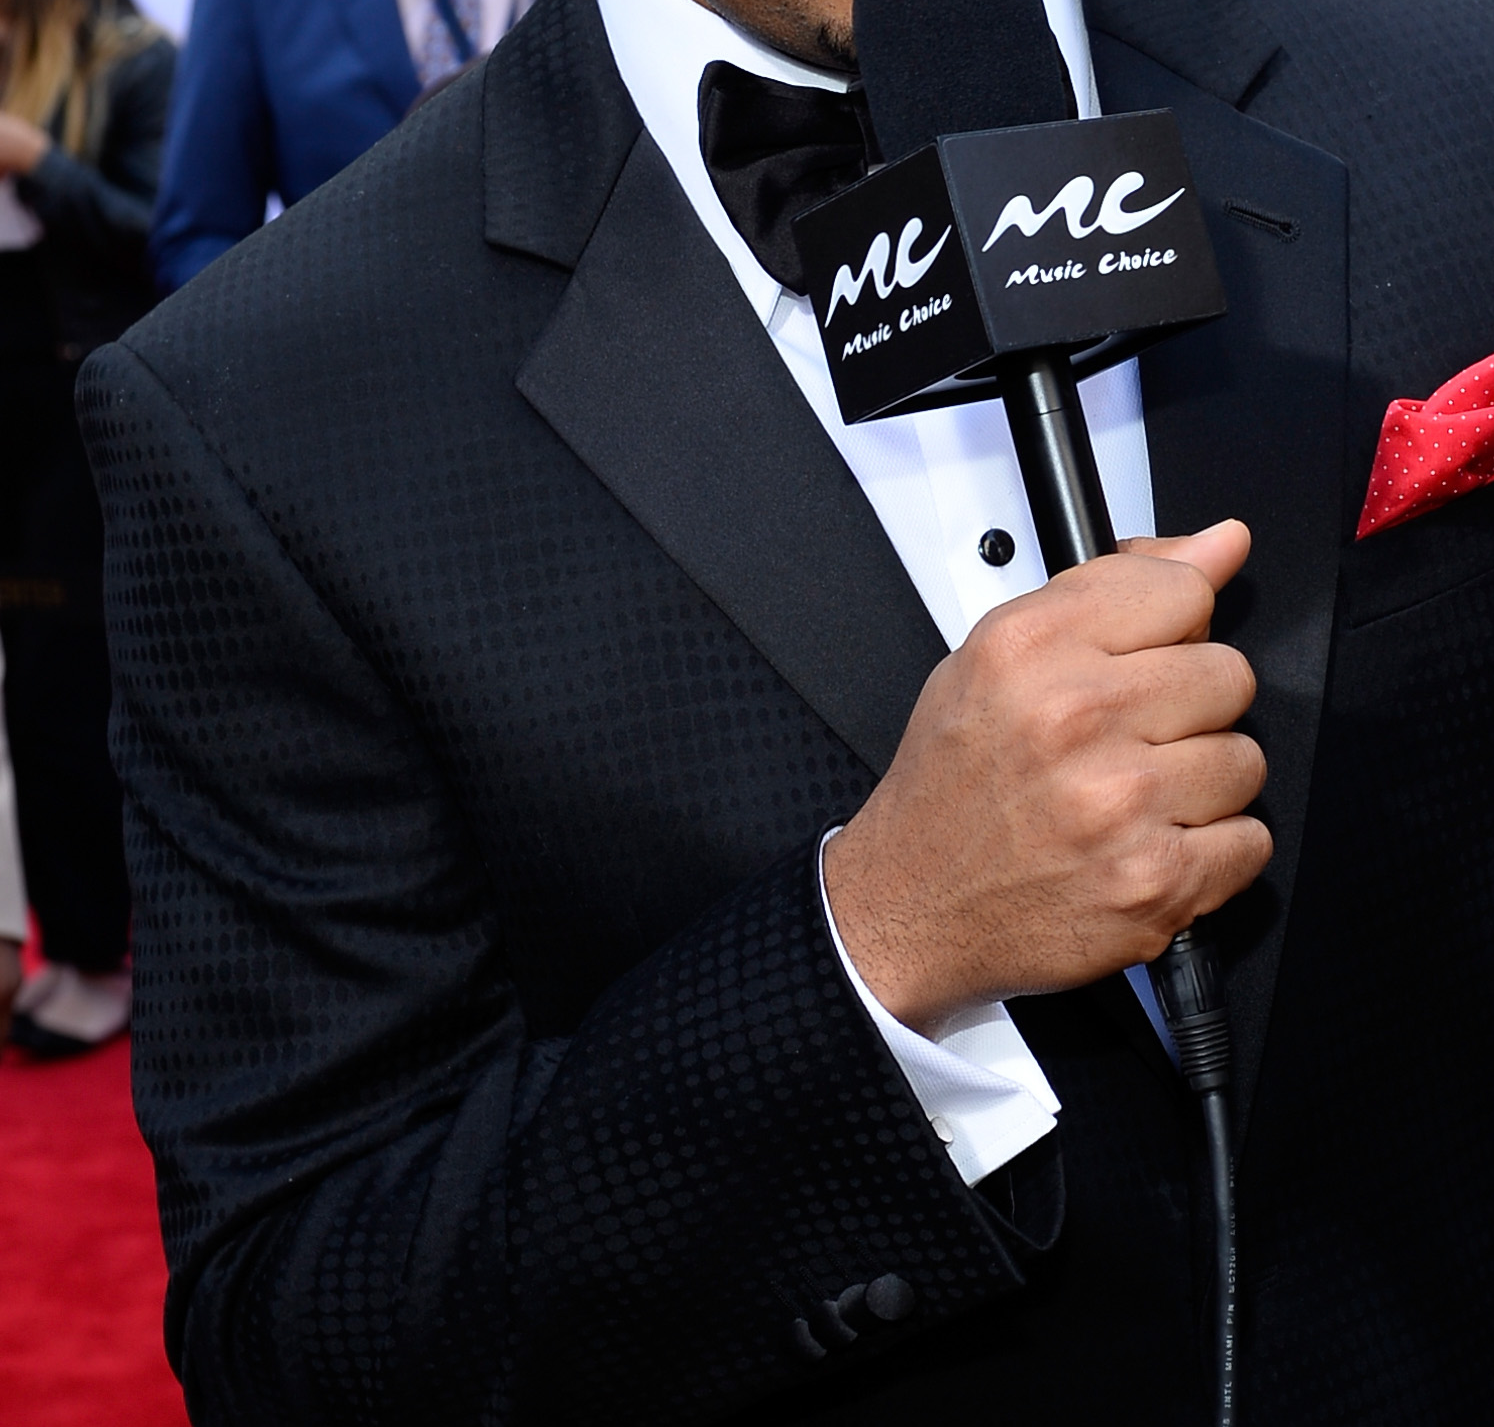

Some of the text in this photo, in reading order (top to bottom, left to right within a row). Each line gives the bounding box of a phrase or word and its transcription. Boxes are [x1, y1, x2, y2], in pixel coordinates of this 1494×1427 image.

[982, 171, 1186, 253] MC
[824, 216, 952, 328] MC
[1004, 247, 1178, 289] Music Choice
[841, 293, 953, 362] Music Choice
[1224, 1335, 1234, 1372] MIAMI
[1223, 1381, 1233, 1409] INTL
